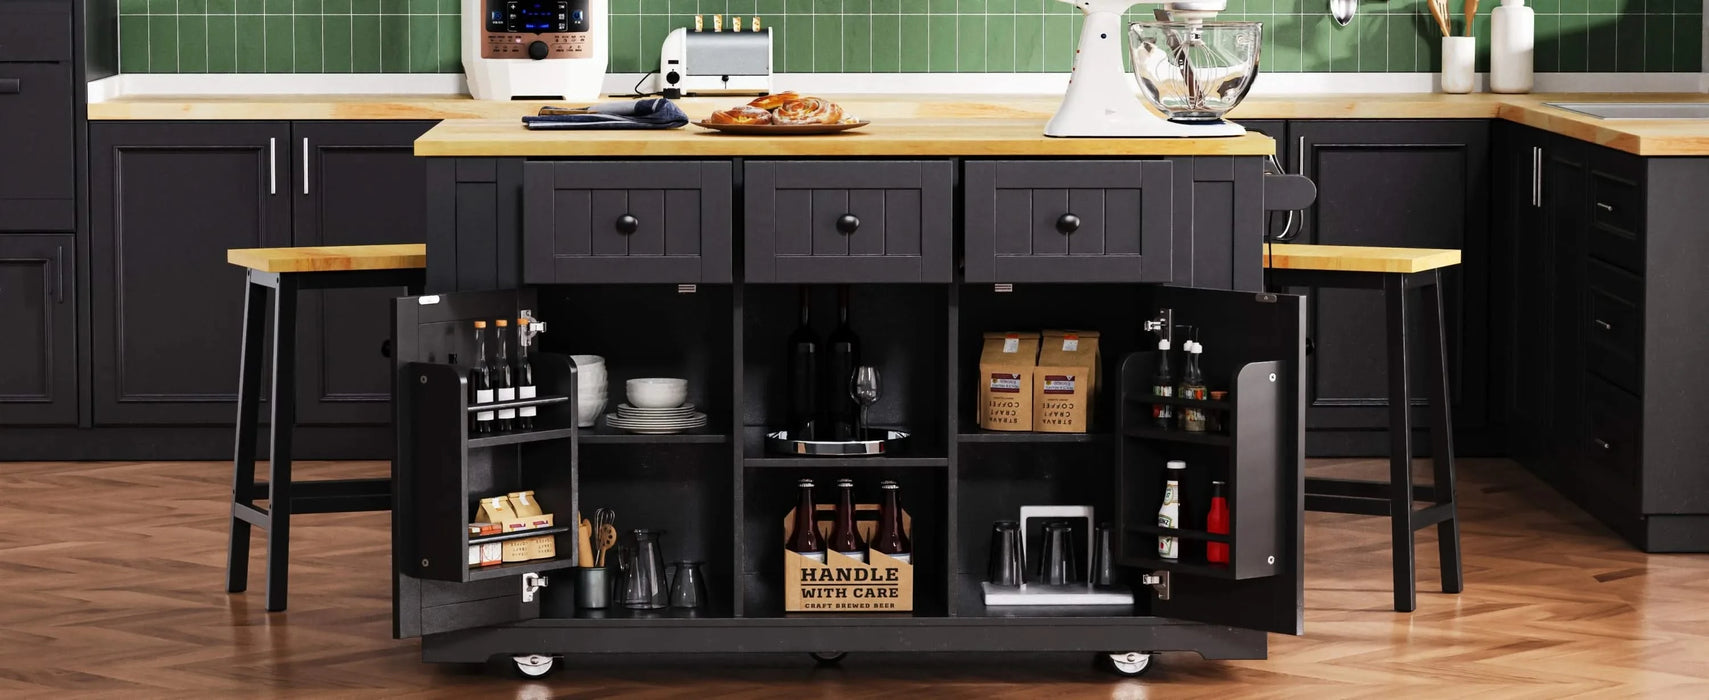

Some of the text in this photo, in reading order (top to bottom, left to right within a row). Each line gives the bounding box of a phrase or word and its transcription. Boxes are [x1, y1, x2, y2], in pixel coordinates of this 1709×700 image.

[801, 568, 898, 581] HANDLE
[802, 588, 898, 598] WITH CARE
